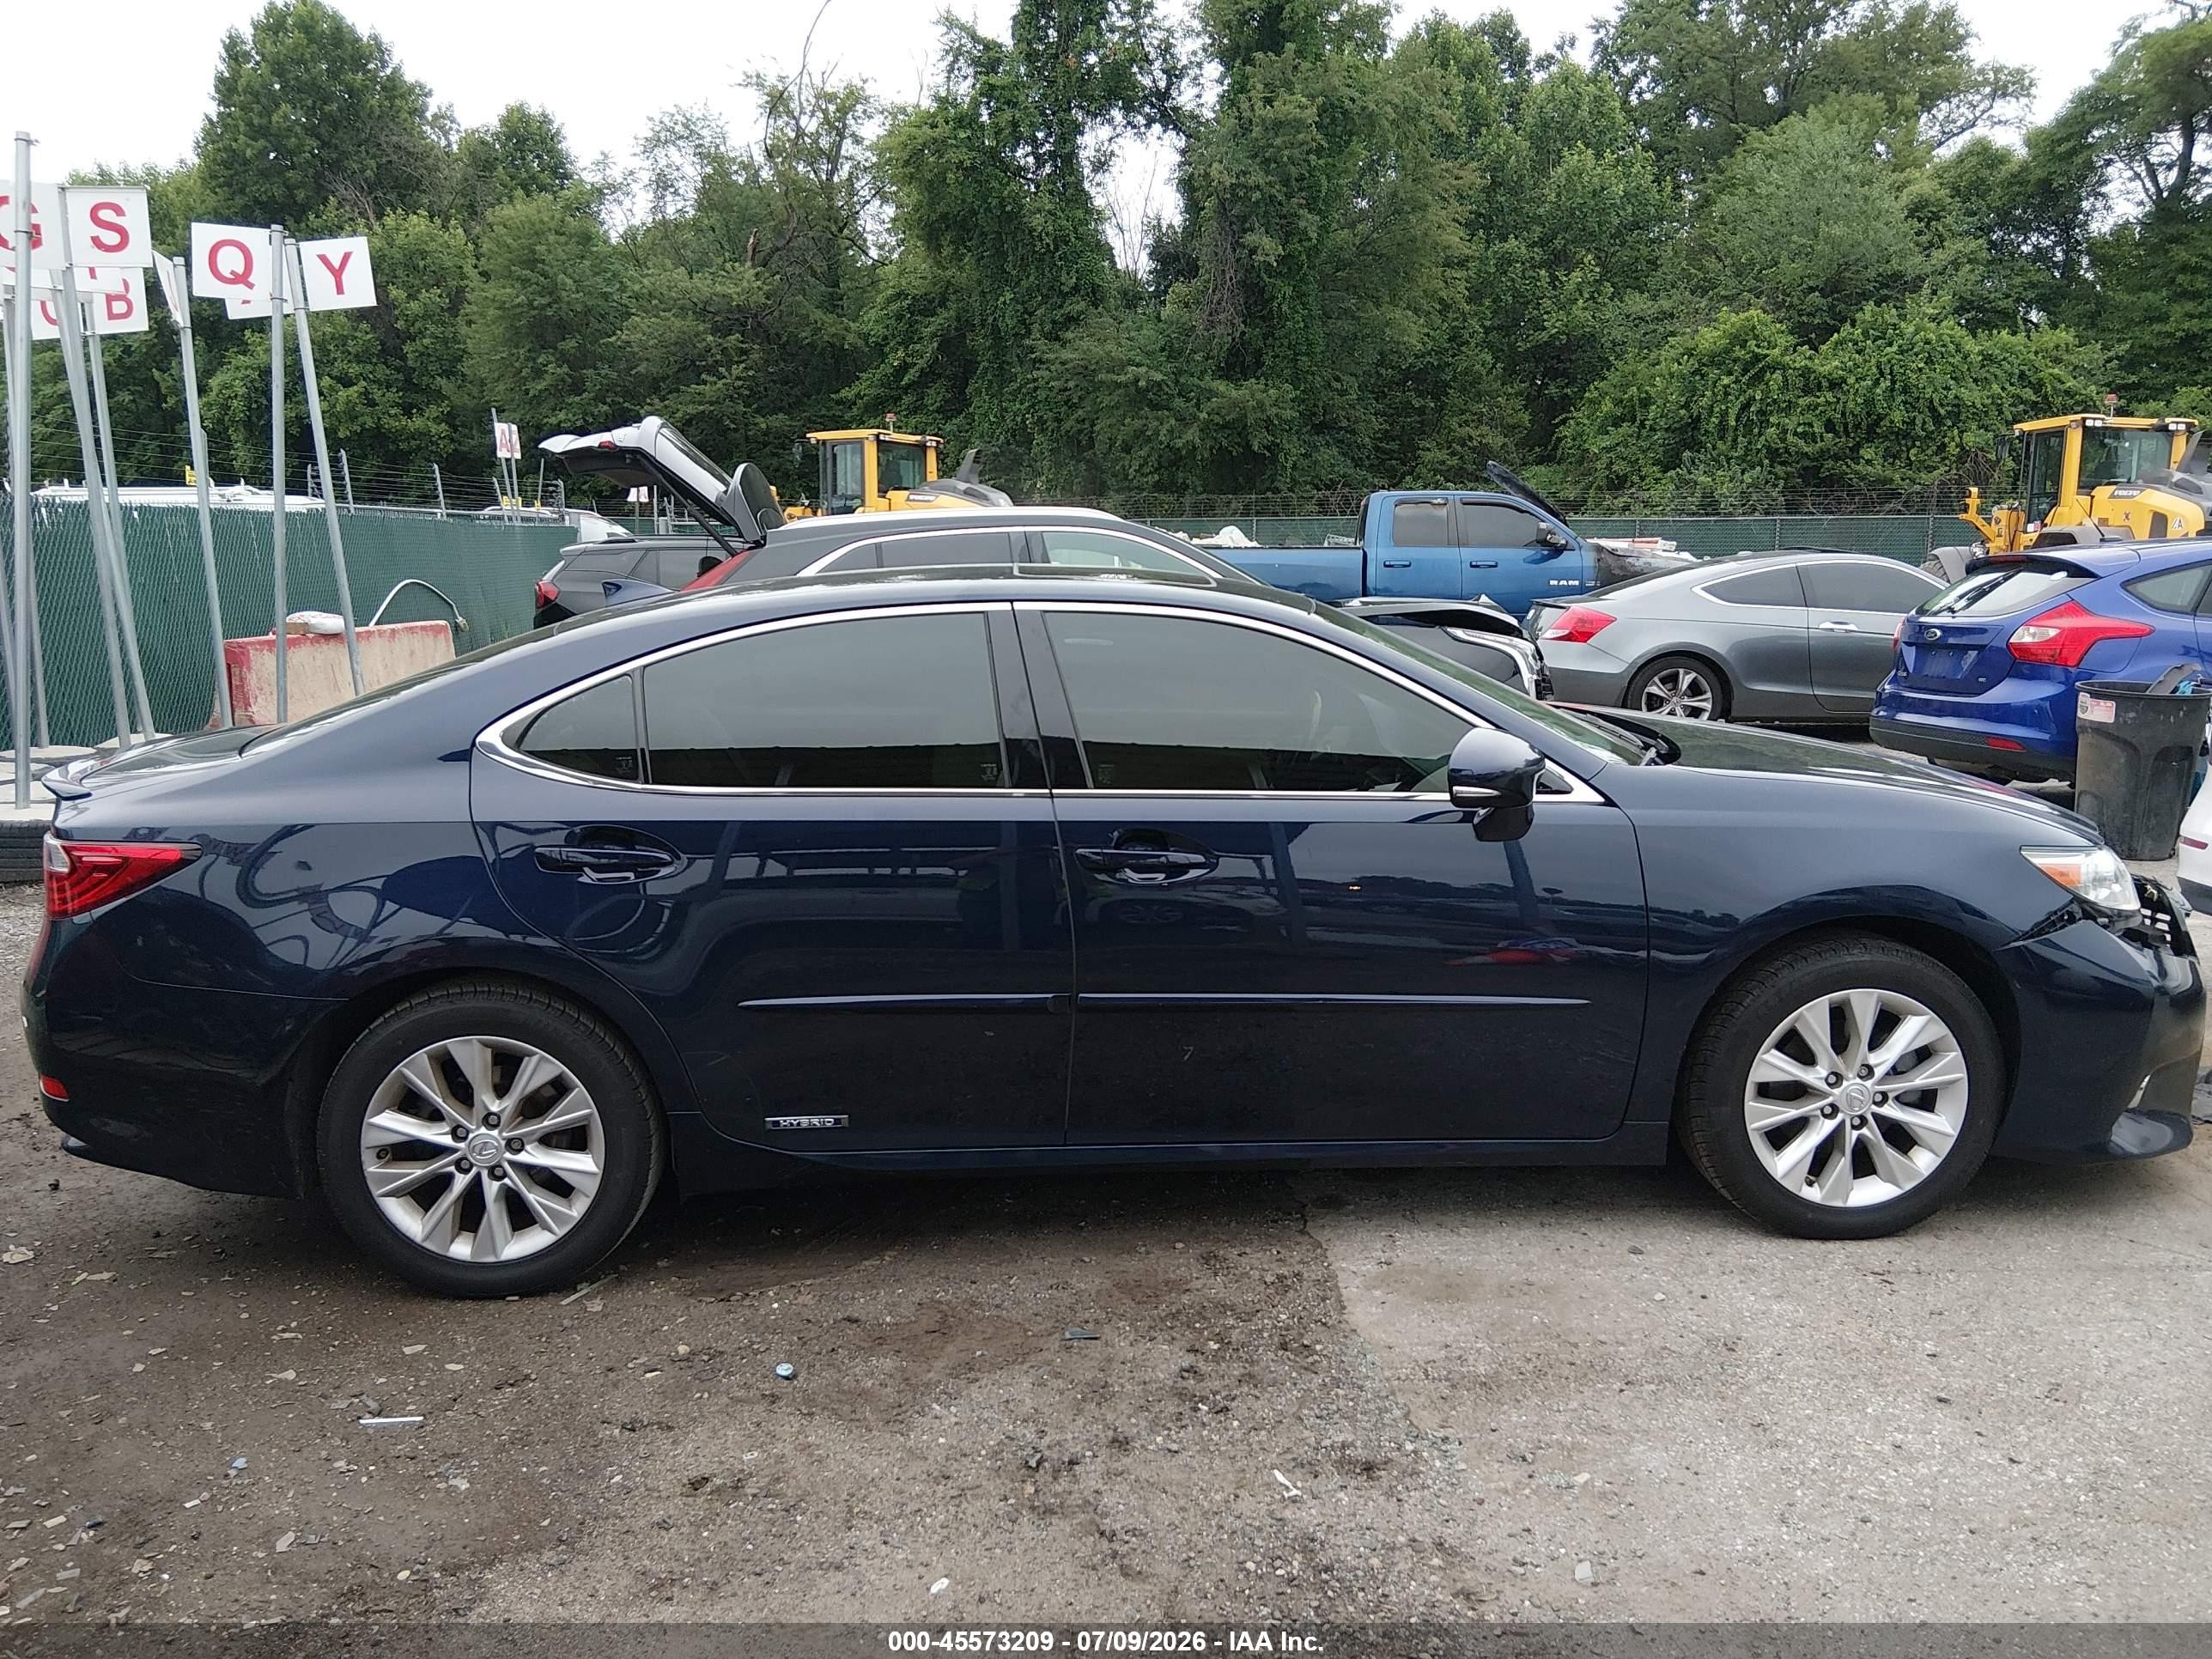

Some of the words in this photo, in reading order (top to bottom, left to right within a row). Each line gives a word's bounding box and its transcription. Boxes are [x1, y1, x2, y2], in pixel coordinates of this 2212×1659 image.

[89, 201, 131, 253] S
[208, 239, 256, 290] Q
[316, 251, 353, 295] Y
[780, 1118, 834, 1127] HYBRID
